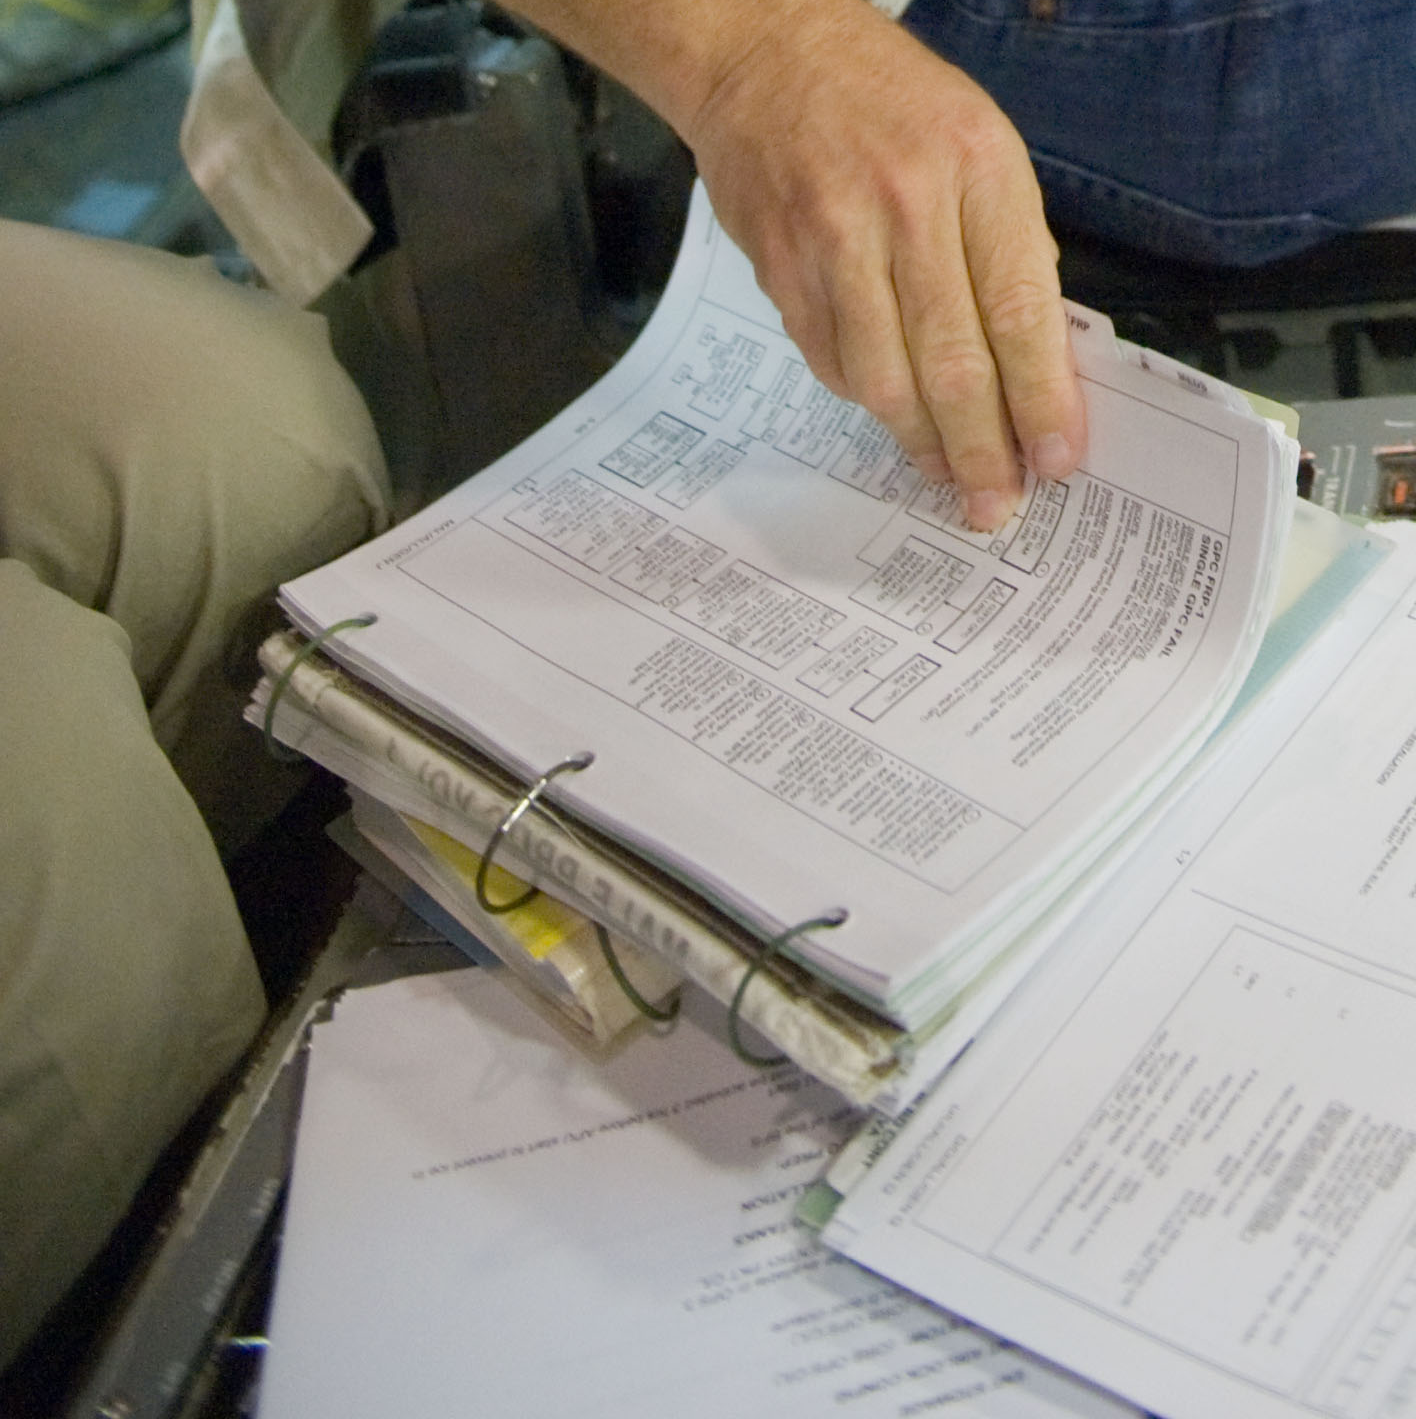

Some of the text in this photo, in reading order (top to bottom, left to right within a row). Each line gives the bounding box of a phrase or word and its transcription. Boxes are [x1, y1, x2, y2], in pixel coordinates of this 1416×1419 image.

[1155, 531, 1213, 662] SINGLE GPC FAIL
[1193, 538, 1226, 621] GPC FRP-1
